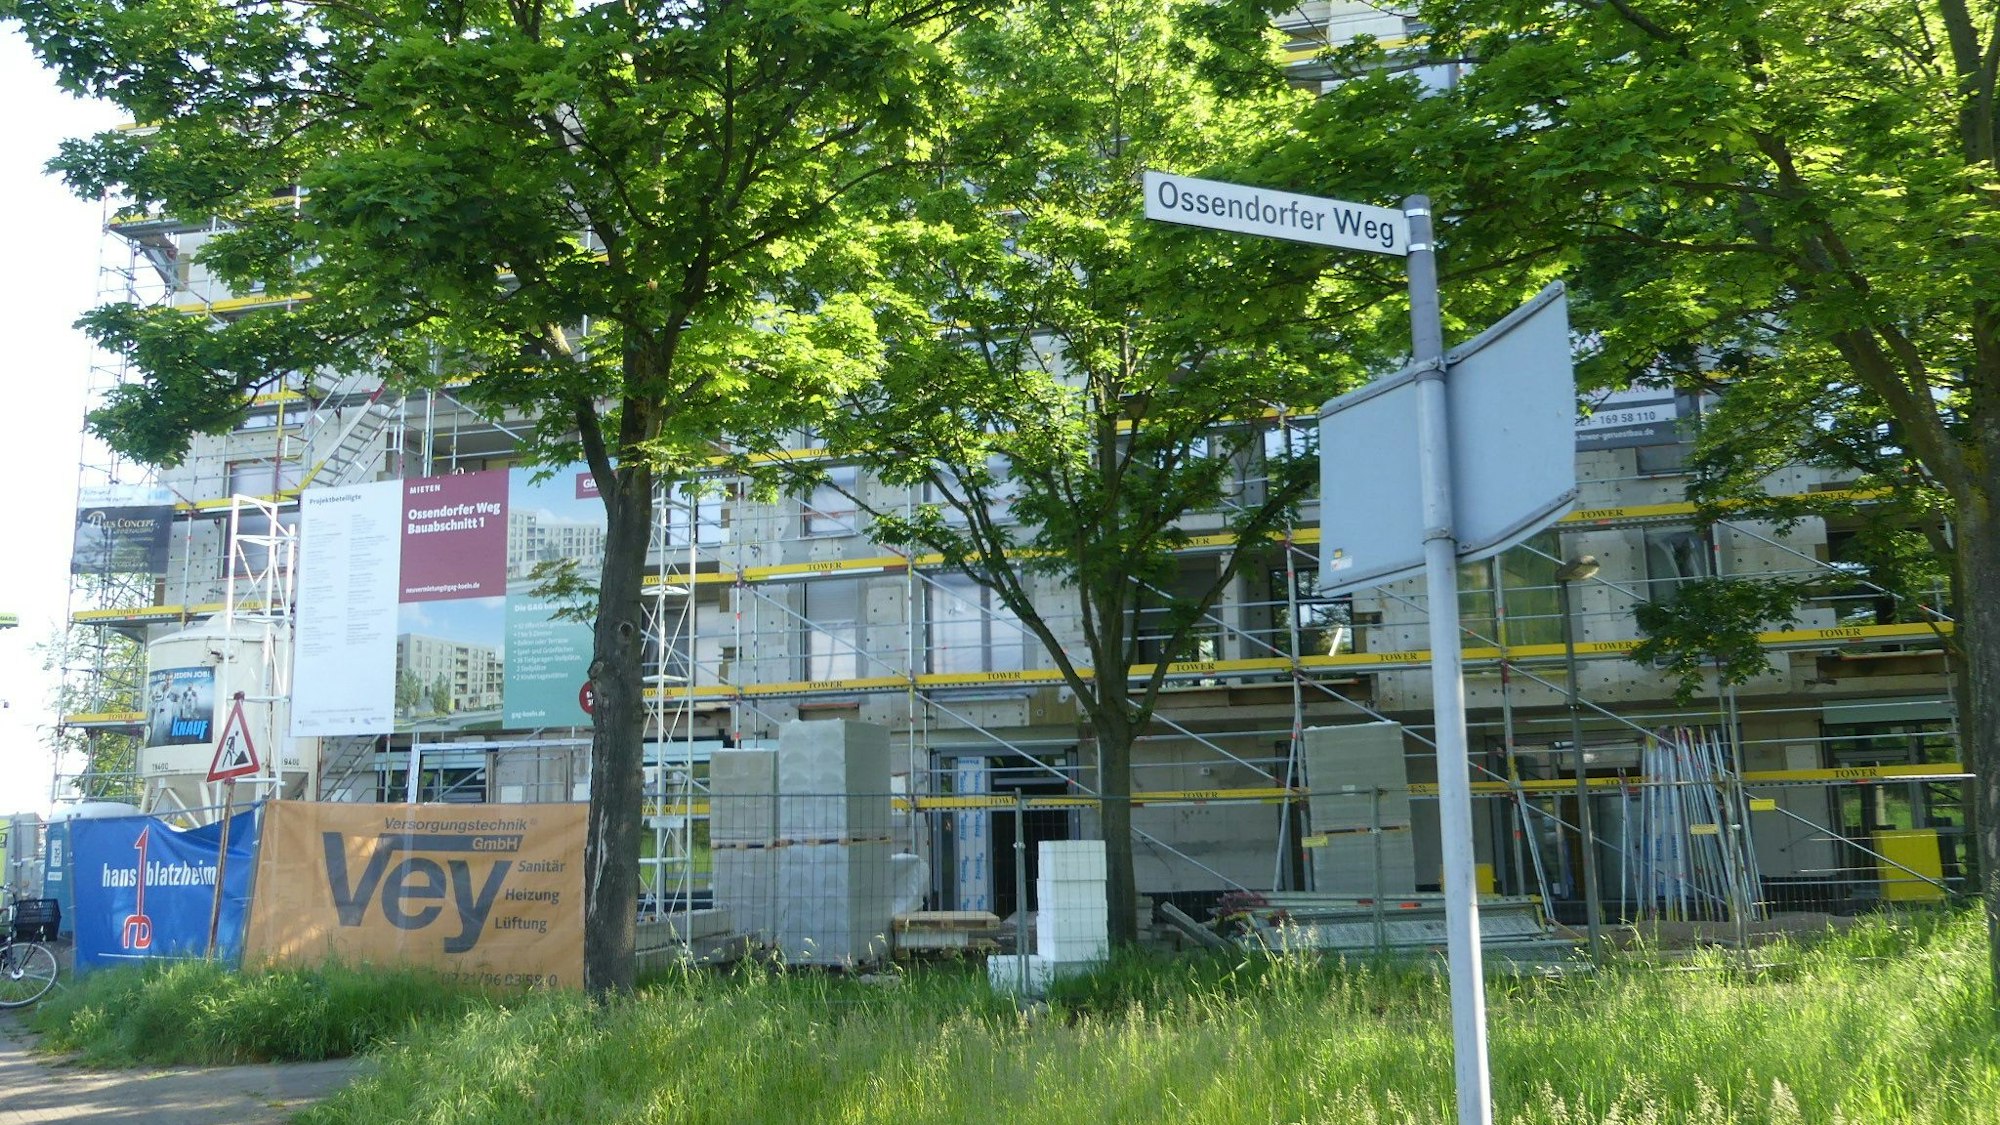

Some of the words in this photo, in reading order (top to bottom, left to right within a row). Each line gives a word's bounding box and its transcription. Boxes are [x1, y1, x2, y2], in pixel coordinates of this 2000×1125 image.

[1158, 181, 1325, 231] Ossendorfer
[1333, 207, 1394, 248] Weg
[1600, 414, 1618, 425] 169
[1621, 413, 1634, 423] 58
[1637, 411, 1656, 421] 110
[409, 484, 441, 494] MIETEN
[583, 479, 598, 489] GA
[309, 494, 362, 506] Projektbeteiligte
[408, 504, 475, 520] Ossendorfer
[476, 502, 501, 515] Weg
[1579, 508, 1624, 518] TOWER
[407, 518, 478, 535] Bauabschnitt
[479, 516, 485, 528] 1
[807, 562, 842, 571] TOWER
[527, 603, 543, 612] GAG
[1819, 628, 1862, 637] TOWER
[1592, 640, 1633, 651] TOWER
[1379, 652, 1418, 662] TOWER
[1175, 662, 1216, 672] TOWER
[987, 671, 1022, 681] TOWER
[808, 681, 843, 690] TOWER
[172, 718, 208, 739] KNAUF
[1833, 768, 1878, 778] TOWER
[1605, 776, 1643, 785] TOER
[1182, 790, 1219, 799] TOWER
[384, 817, 527, 834] Versorgungstechnik
[472, 837, 519, 850] GmbH
[518, 859, 566, 873] Sanitär
[102, 862, 137, 888] hans
[145, 860, 217, 887] blatzheim
[322, 832, 513, 954] Vey
[505, 888, 560, 905] Heizung
[495, 917, 548, 934] Lüftung
